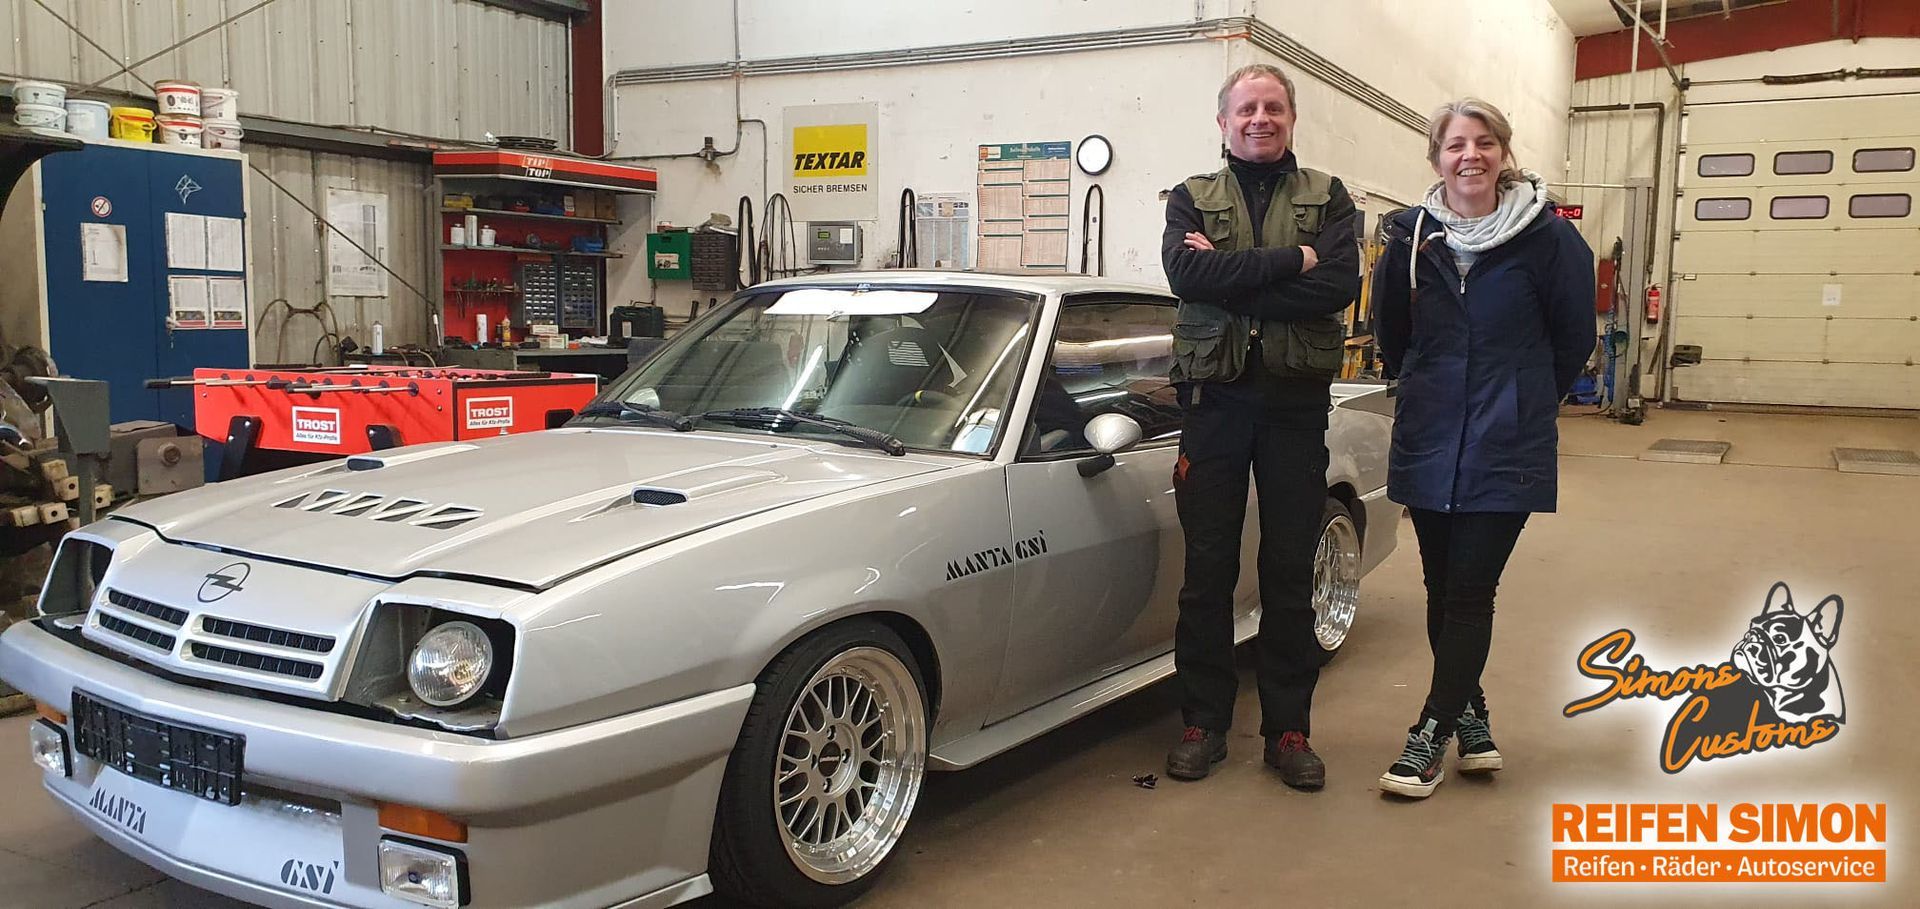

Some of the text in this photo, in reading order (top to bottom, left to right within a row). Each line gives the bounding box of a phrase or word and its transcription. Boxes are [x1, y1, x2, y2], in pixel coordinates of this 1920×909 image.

[527, 157, 545, 167] TIP
[794, 151, 865, 171] TEXTAR
[528, 168, 549, 178] TOP
[793, 183, 868, 194] SICHER BREMSEN
[471, 406, 509, 418] TROST
[296, 418, 336, 432] TROST
[946, 546, 1013, 581] MANTA
[89, 786, 147, 834] MANTA
